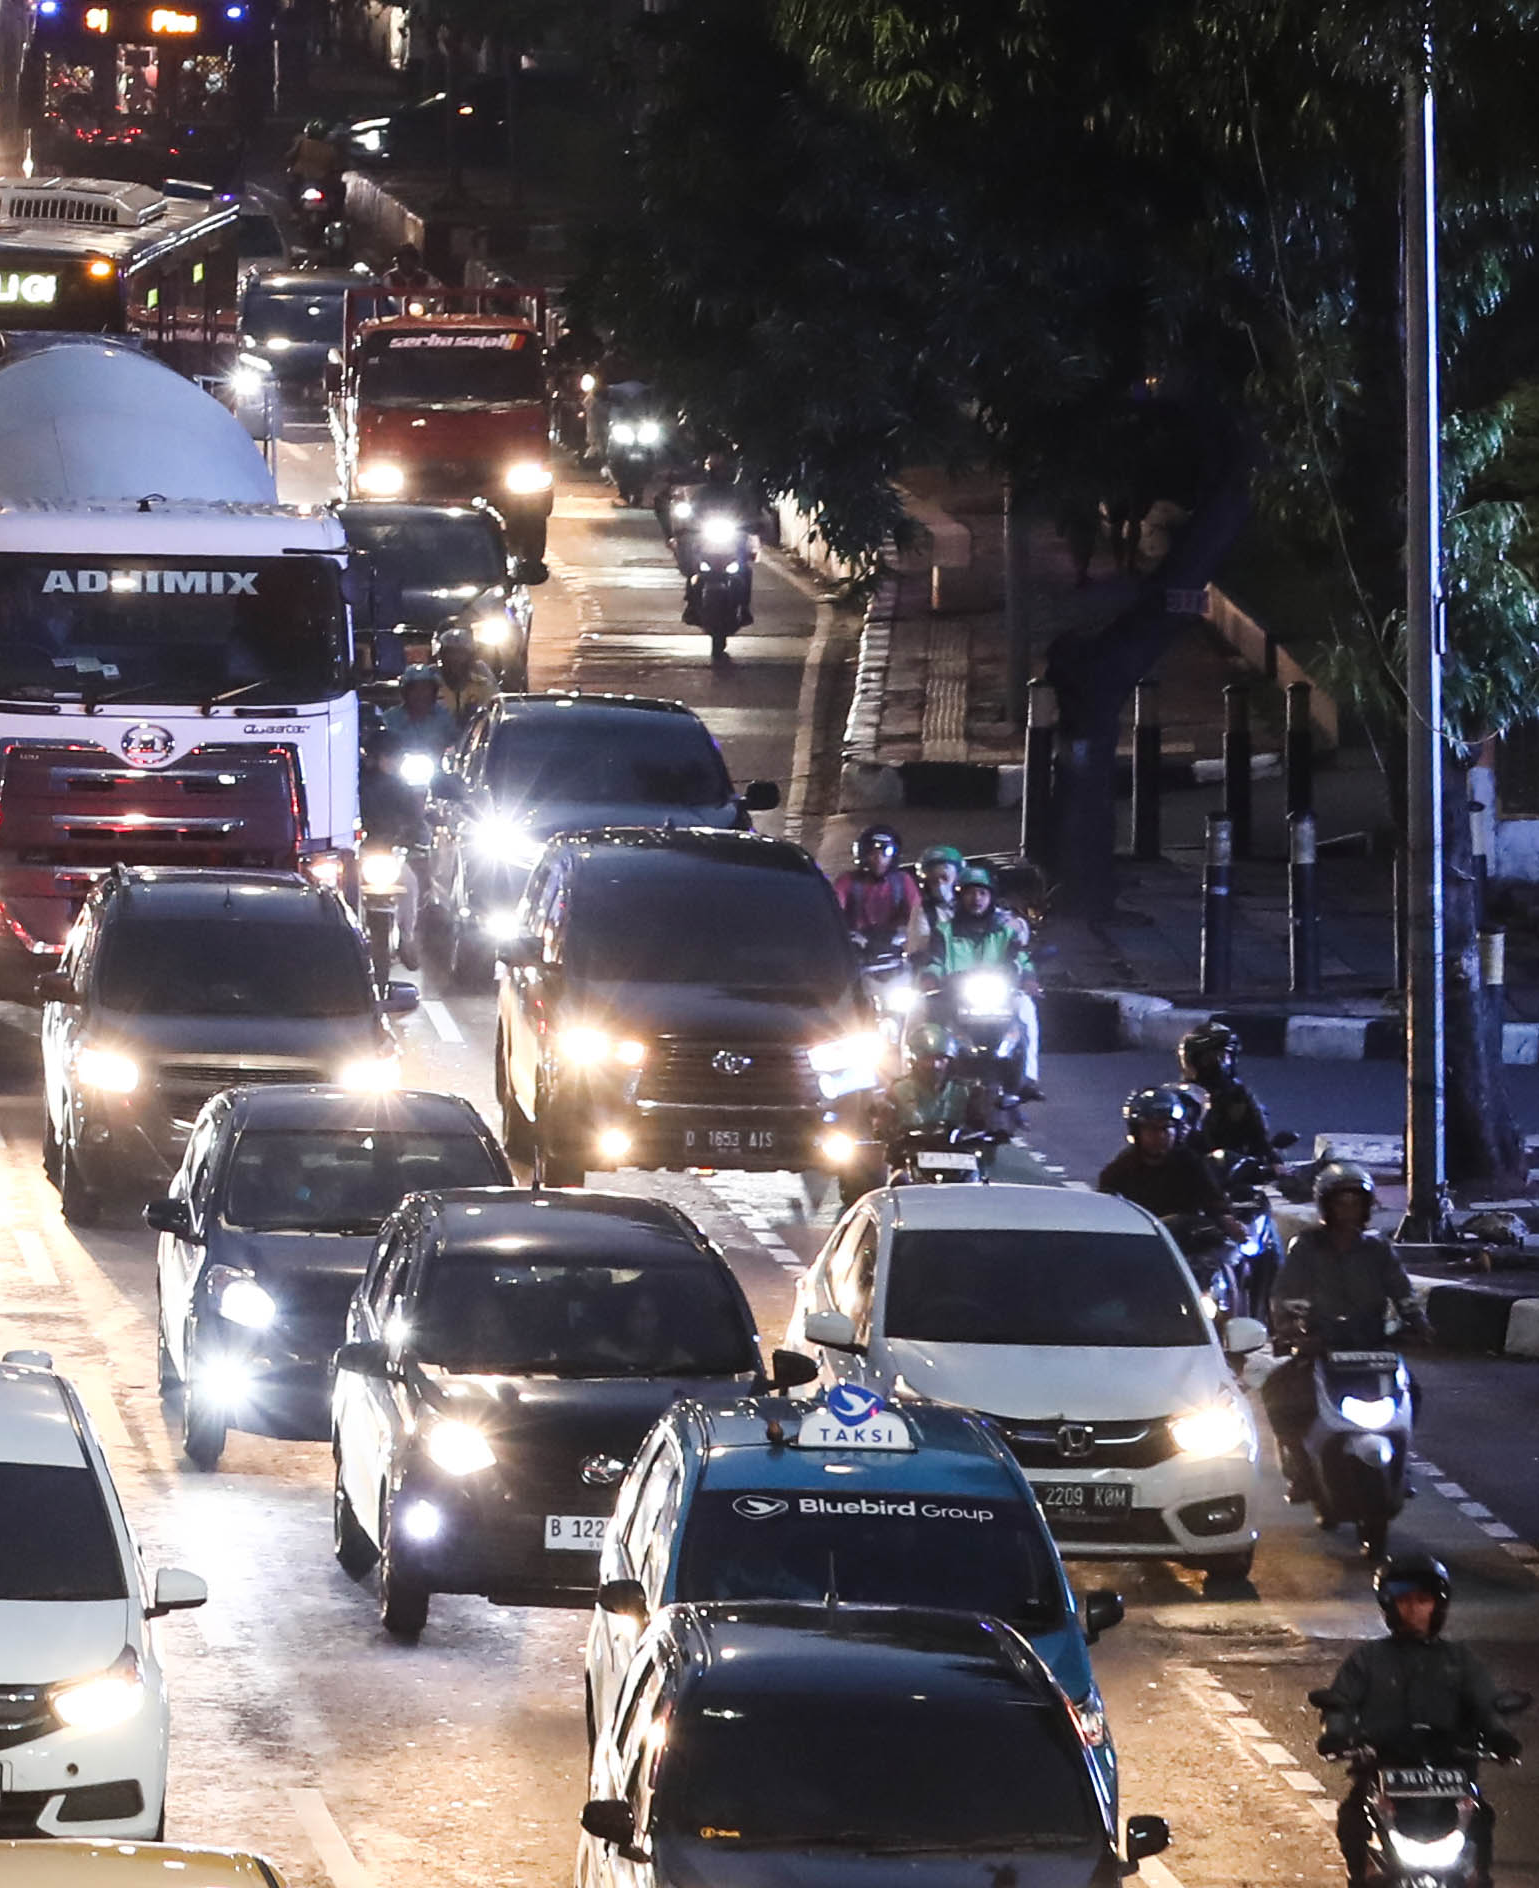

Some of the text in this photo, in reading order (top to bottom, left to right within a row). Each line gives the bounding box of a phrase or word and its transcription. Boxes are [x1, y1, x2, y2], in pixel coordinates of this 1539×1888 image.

[41, 570, 259, 595] ADHIMIX
[820, 1428, 894, 1443] TAKSI
[1046, 1486, 1083, 1505] 2209
[799, 1498, 995, 1522] Bluebird Group
[551, 1519, 609, 1538] B 122
